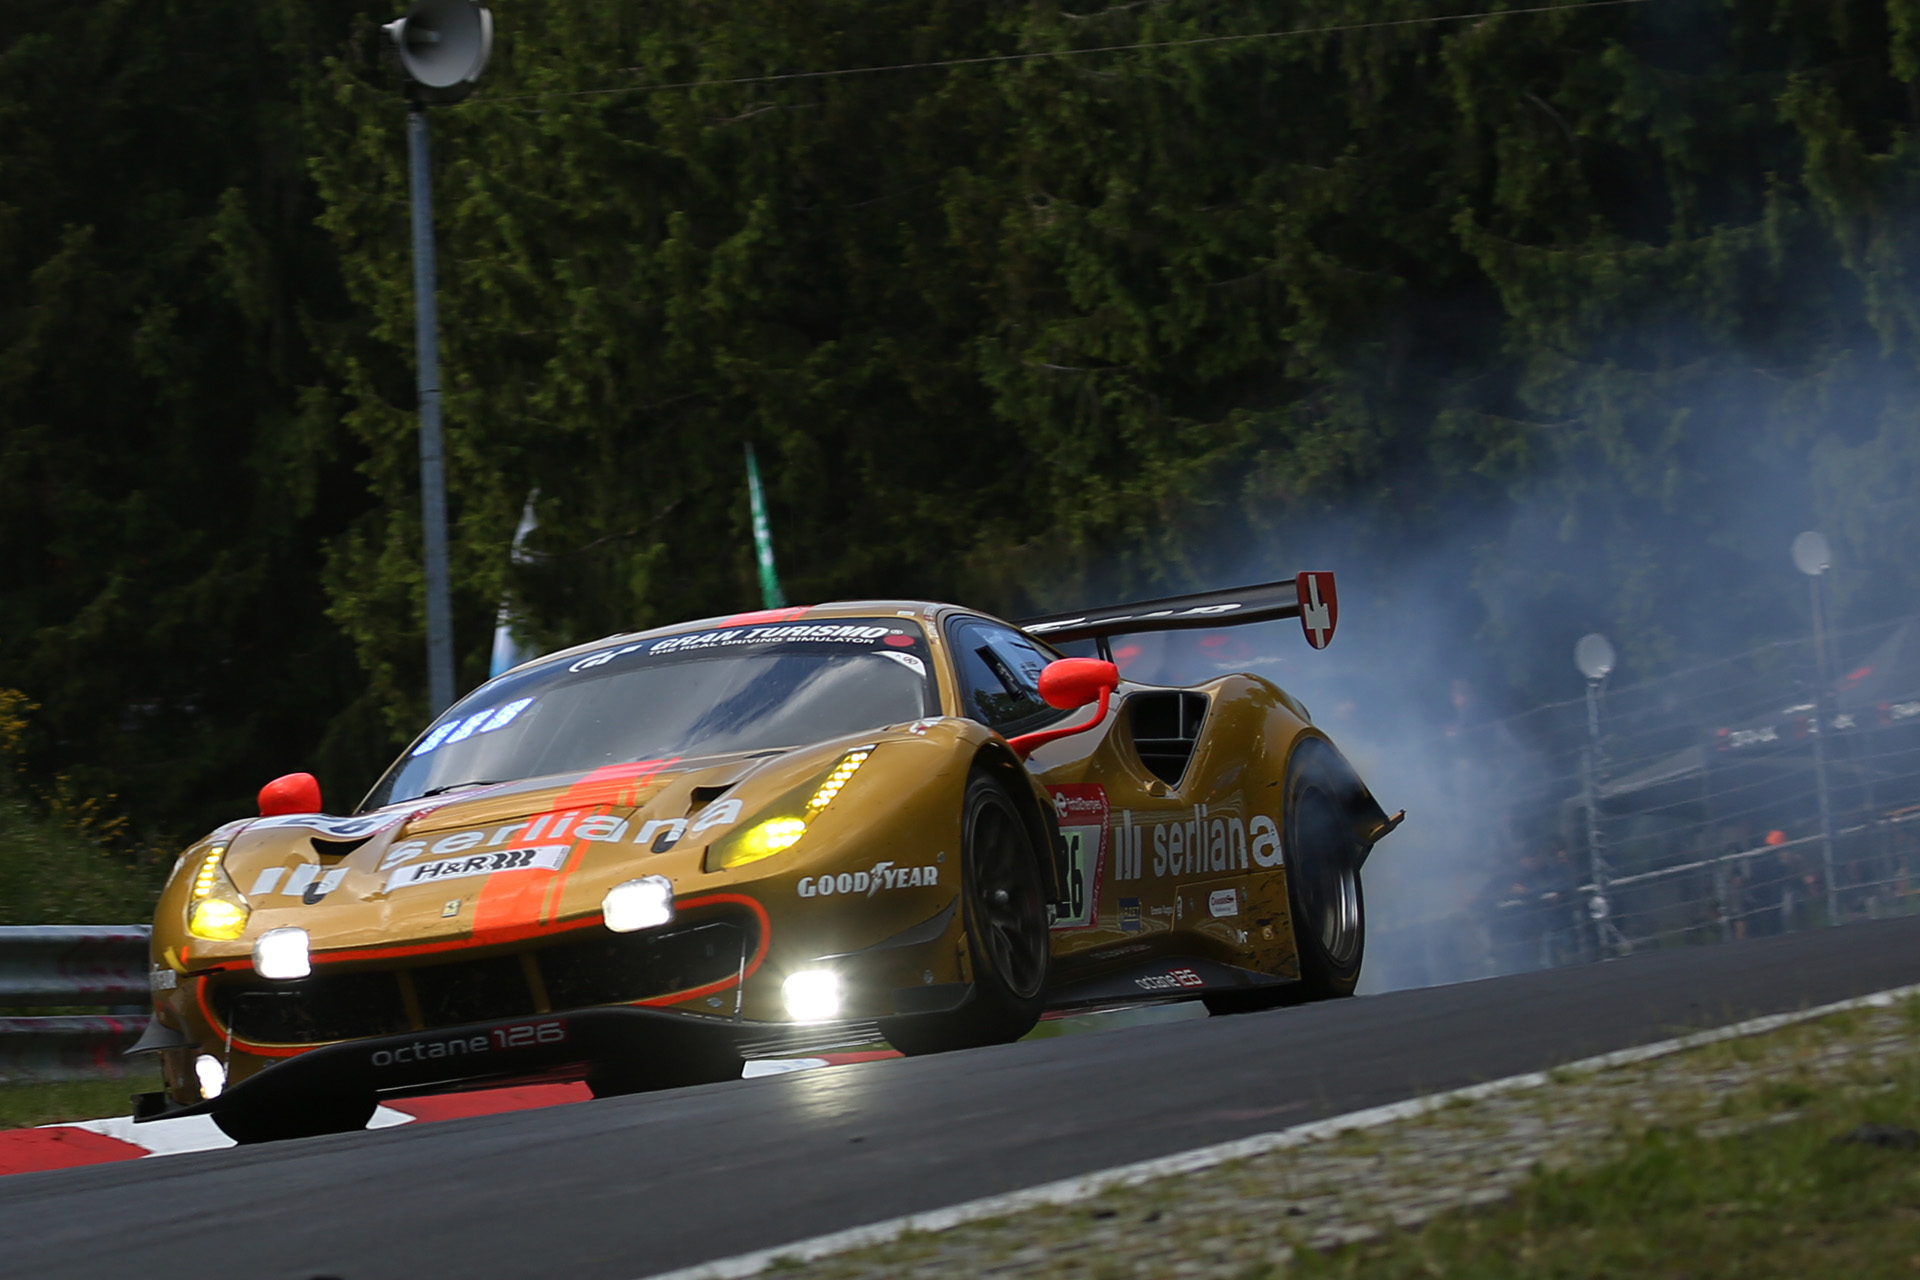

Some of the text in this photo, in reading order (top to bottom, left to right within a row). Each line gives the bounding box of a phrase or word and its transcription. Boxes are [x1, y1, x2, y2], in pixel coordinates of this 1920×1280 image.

[649, 636, 875, 656] THE REAL DRIVING SIMULATOR
[650, 625, 889, 651] GRAN TURISMO
[381, 799, 742, 870] serliana
[1153, 803, 1284, 877] serliana
[412, 856, 489, 881] H&R
[797, 861, 938, 898] GOODYEAR
